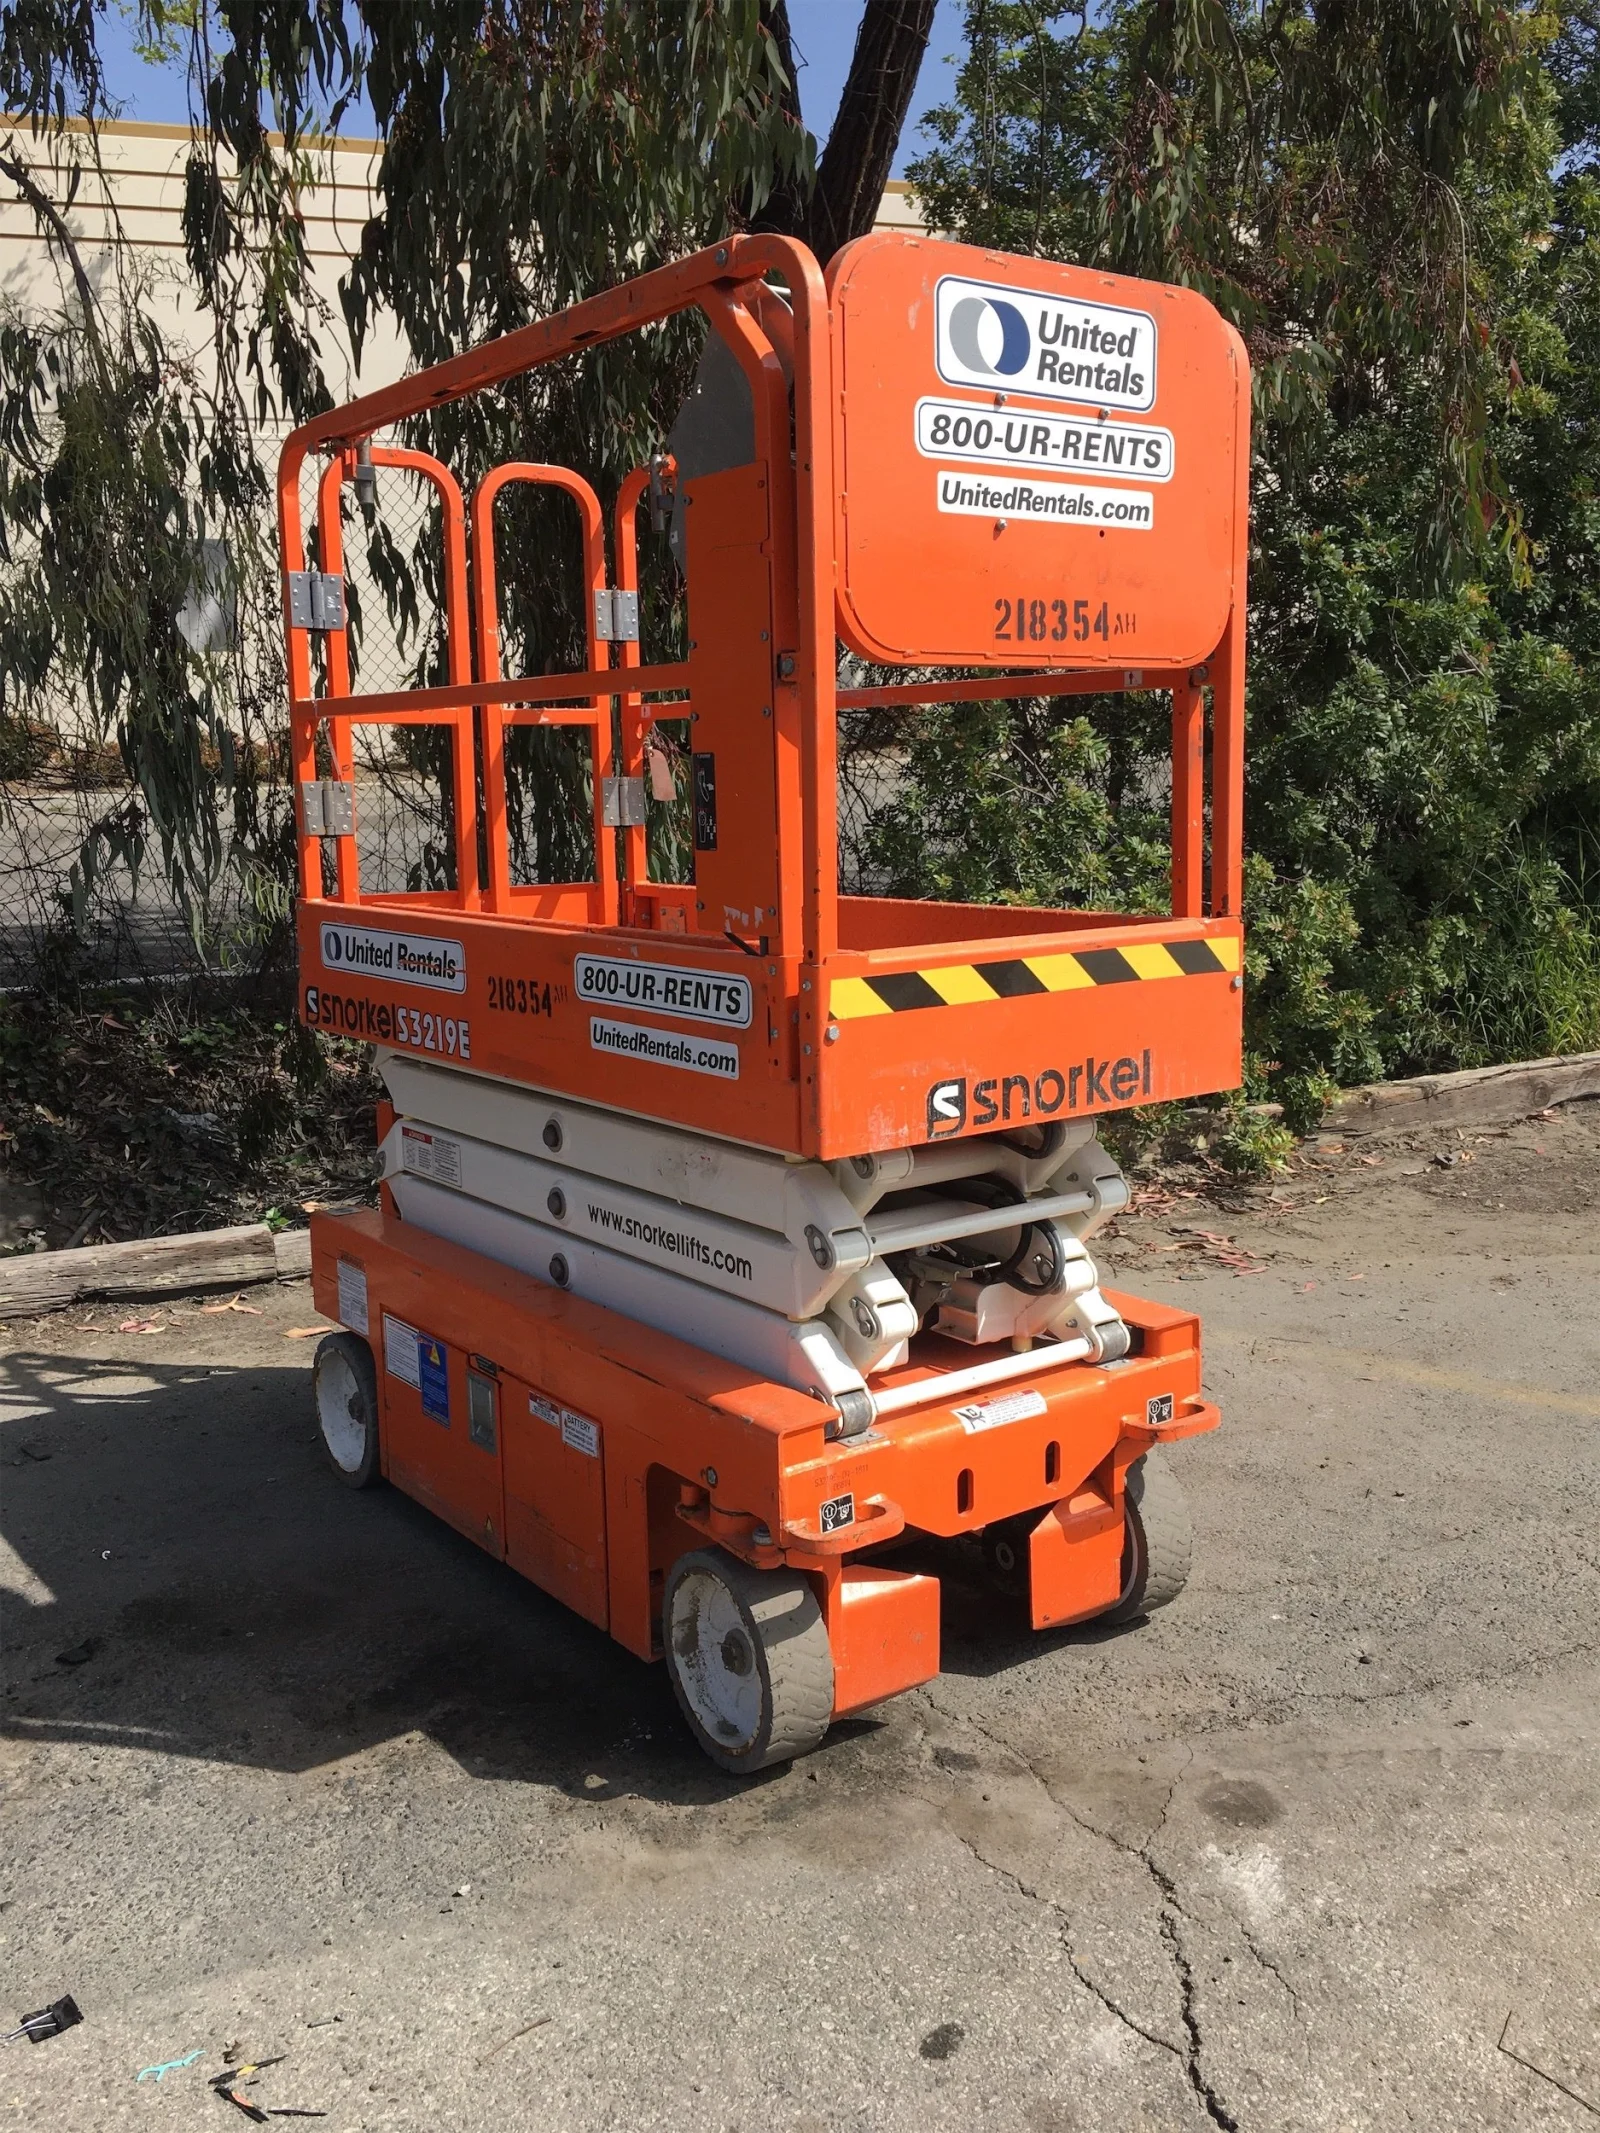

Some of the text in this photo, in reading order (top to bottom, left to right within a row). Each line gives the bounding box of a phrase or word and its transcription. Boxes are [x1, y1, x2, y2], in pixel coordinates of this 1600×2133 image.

[1038, 310, 1138, 358] United
[1036, 348, 1145, 396] Rentals
[930, 413, 1162, 469] 800-UR-RENTS
[942, 479, 1150, 522] UnitedRentals.com
[994, 598, 1109, 642] 218354
[345, 935, 457, 980] United Rentals
[488, 975, 552, 1018] 218354
[583, 966, 742, 1015] 800-UR-RENTS
[322, 992, 397, 1041] snorkel
[593, 1023, 737, 1073] UnitedRentals.com
[972, 1048, 1151, 1126] snorkel
[587, 1203, 752, 1281] www.snorkellifts.com
[566, 1413, 591, 1433] BATTERY
